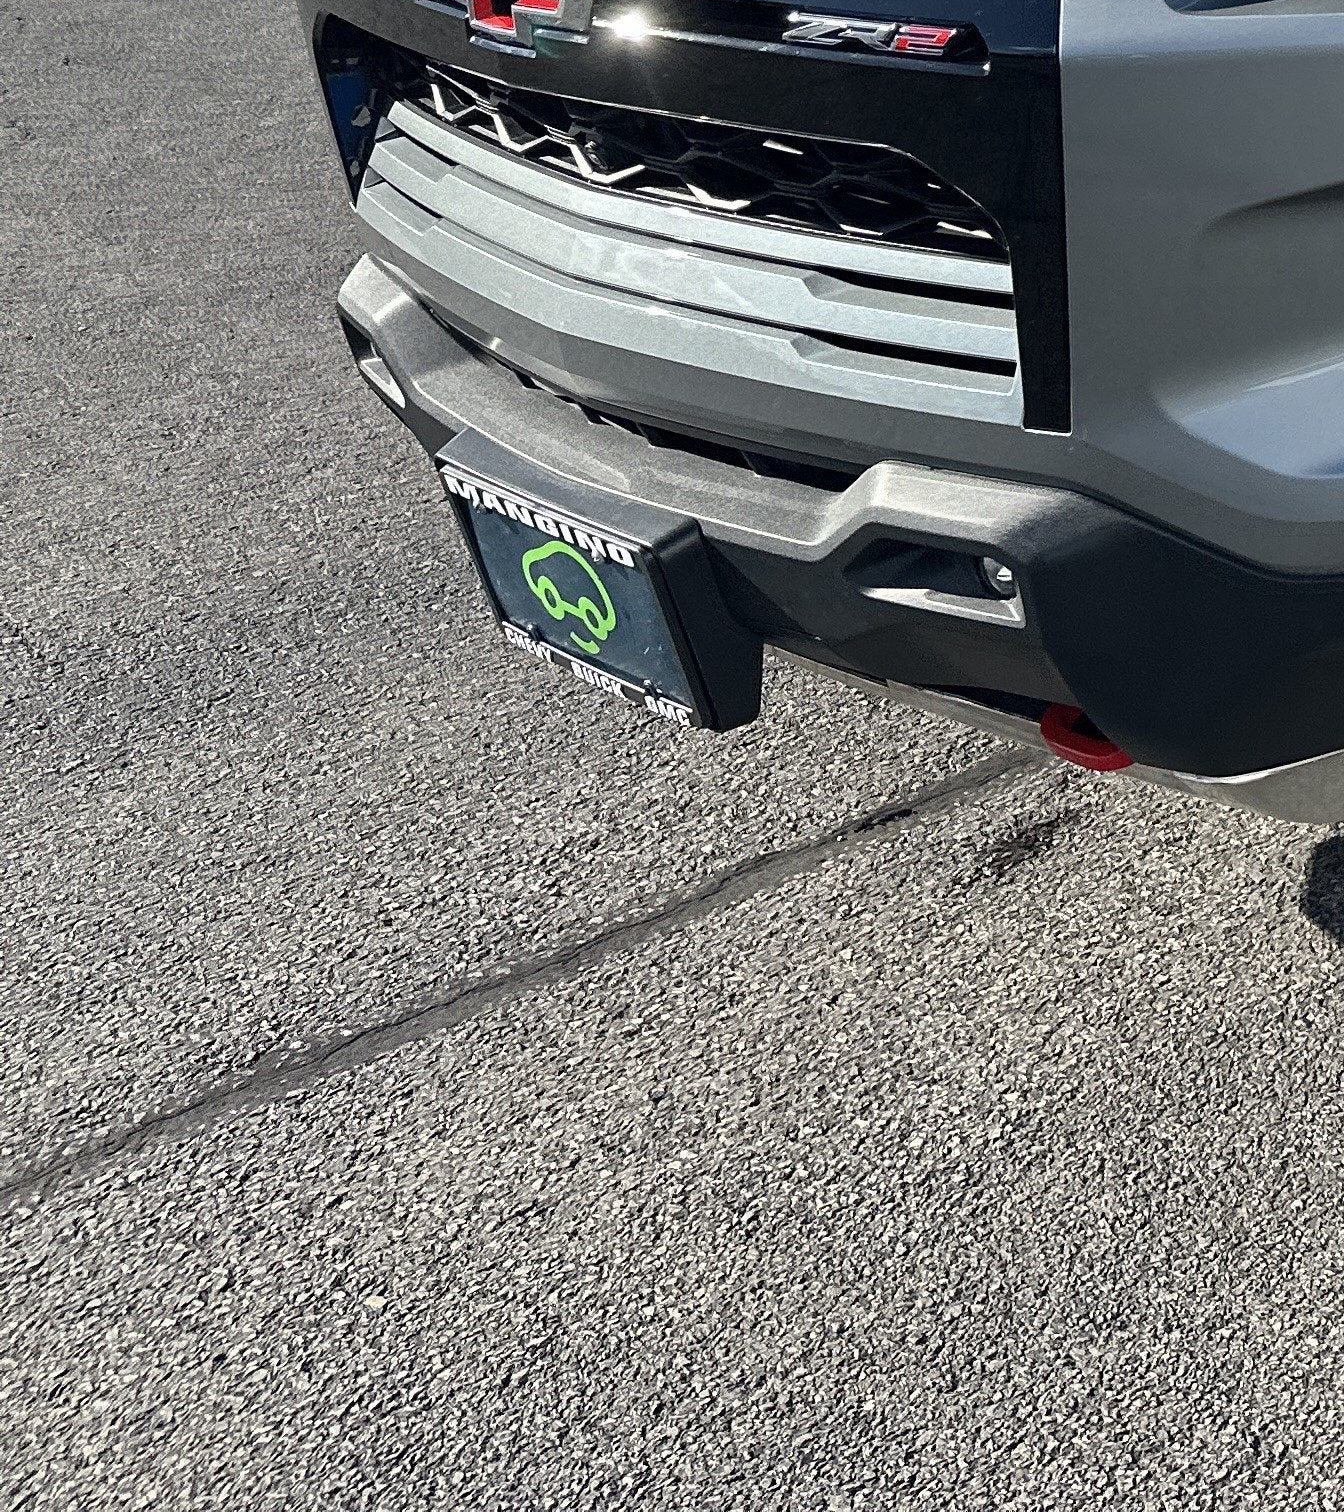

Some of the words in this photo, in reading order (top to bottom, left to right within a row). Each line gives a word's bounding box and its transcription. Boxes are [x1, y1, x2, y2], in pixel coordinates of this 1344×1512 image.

[781, 10, 959, 57] ZR2
[443, 474, 636, 568] MANGINO
[503, 626, 554, 663] CHEVY
[570, 661, 629, 701] BUICK
[644, 694, 691, 727] GMC
